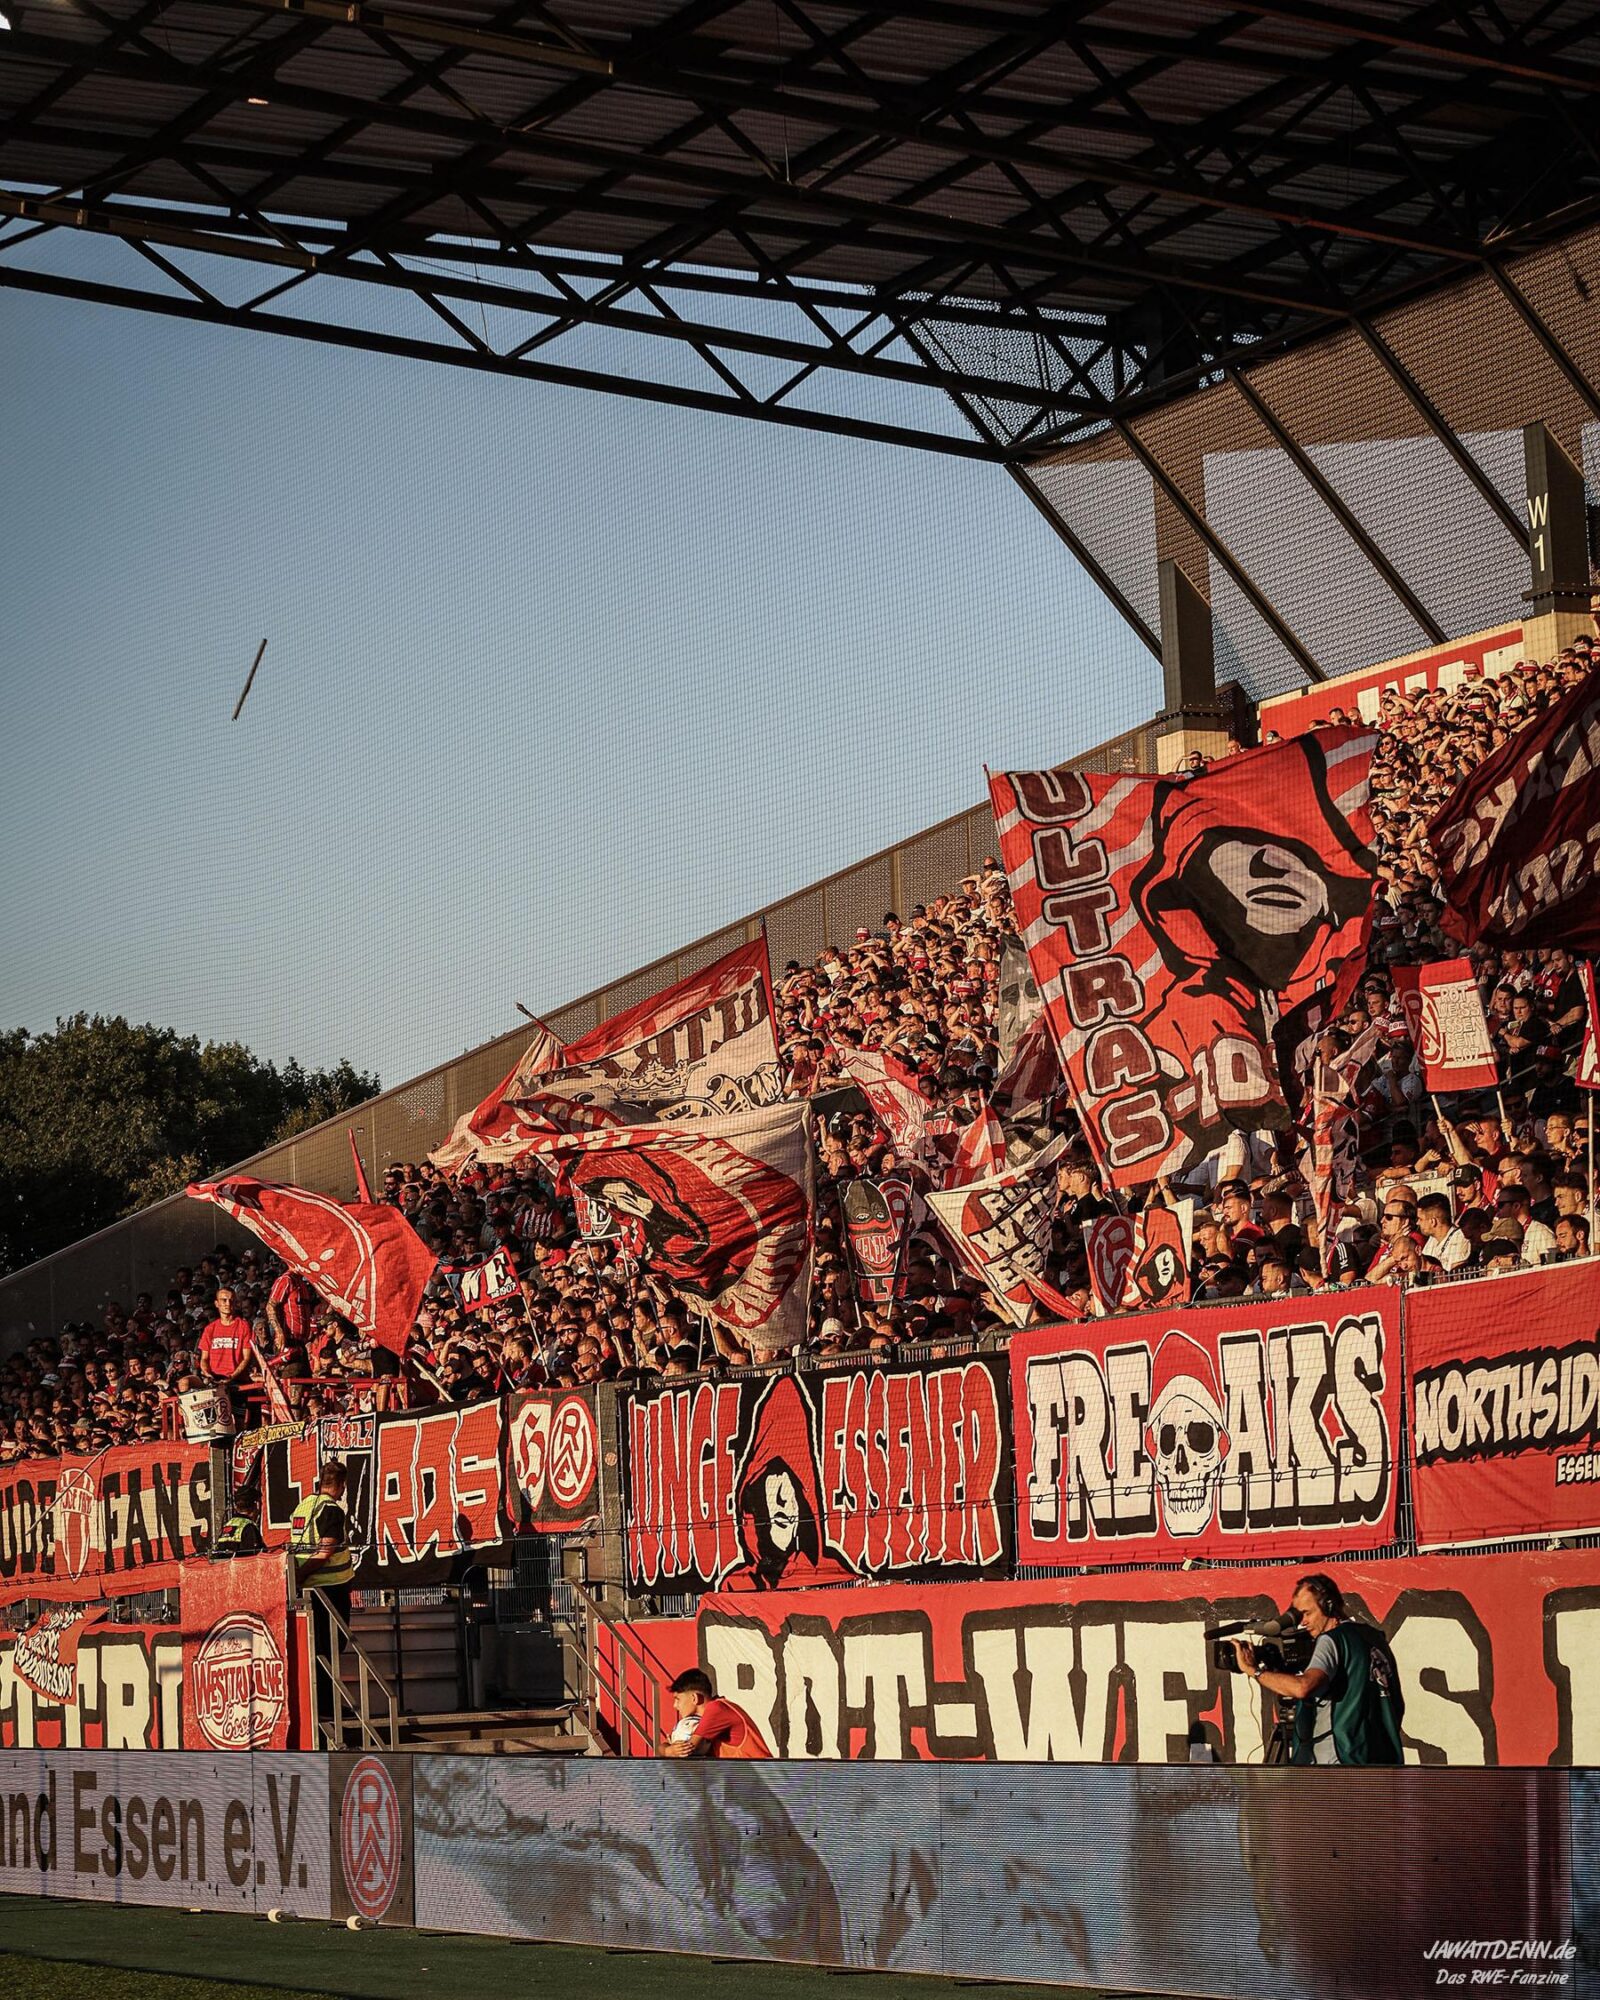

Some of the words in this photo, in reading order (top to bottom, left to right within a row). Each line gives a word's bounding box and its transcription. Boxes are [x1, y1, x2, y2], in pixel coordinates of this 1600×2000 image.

[1007, 770, 1172, 1168] ULTRAS
[627, 1382, 744, 1587] JUNGE
[821, 1361, 1004, 1573] ESSENER
[1027, 1311, 1389, 1544] FREAKS
[1414, 1351, 1600, 1459] NORTHSID
[103, 1462, 212, 1574] FANS
[0, 1769, 57, 1873] nd
[73, 1770, 206, 1883] Essen
[223, 1773, 308, 1889] e.V.
